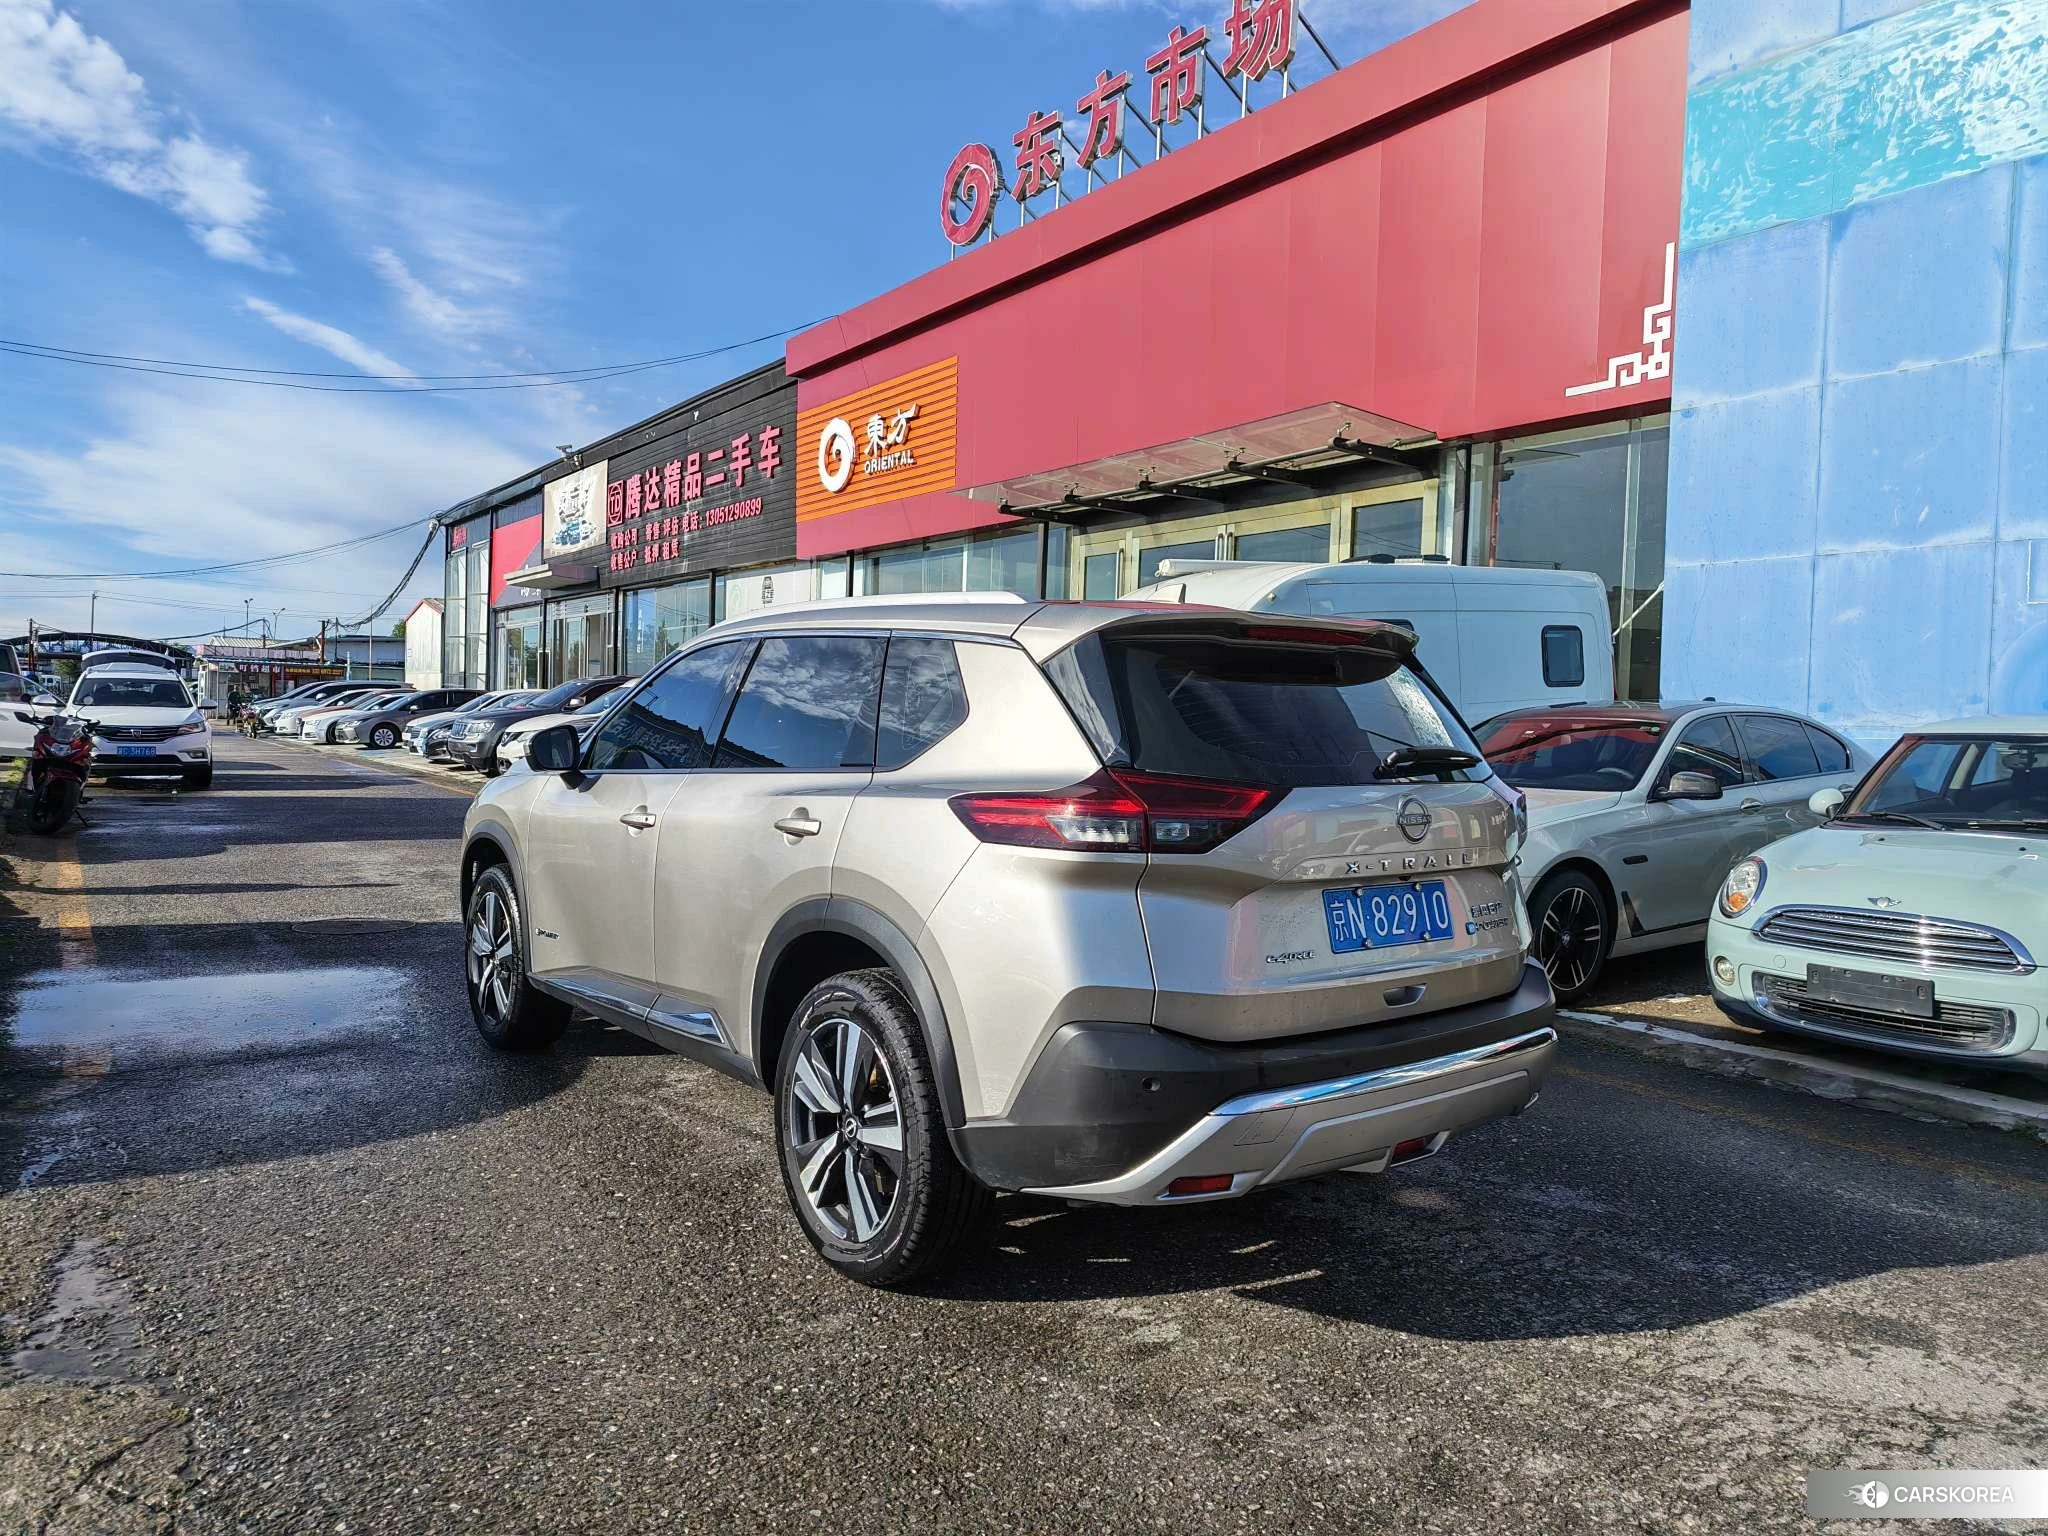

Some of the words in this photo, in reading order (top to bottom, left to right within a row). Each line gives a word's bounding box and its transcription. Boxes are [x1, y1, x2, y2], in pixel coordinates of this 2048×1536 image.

[1011, 0, 1298, 202] 东方市场
[625, 425, 782, 519] 腾达精品二手车
[864, 450, 917, 475] ORIENTAL
[1399, 814, 1432, 825] NISSAN
[1345, 853, 1475, 874] X-TRAIL
